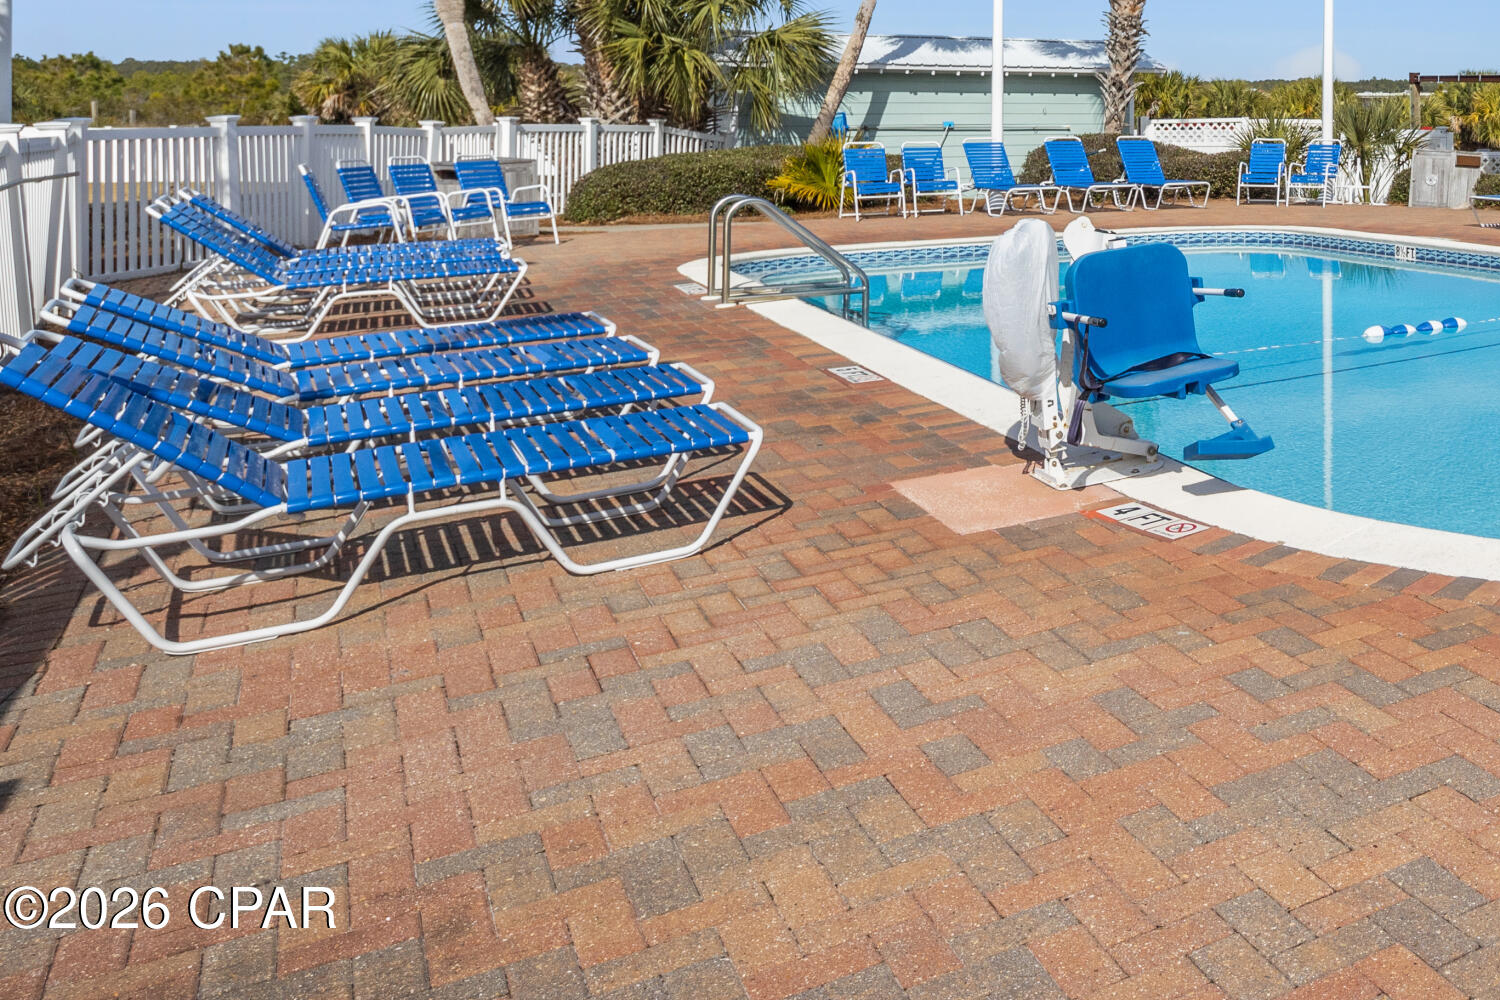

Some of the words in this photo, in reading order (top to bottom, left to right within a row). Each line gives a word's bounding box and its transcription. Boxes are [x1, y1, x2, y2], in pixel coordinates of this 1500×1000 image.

[1406, 247, 1415, 258] FT
[1113, 506, 1141, 516] 4
[1127, 512, 1172, 526] FT
